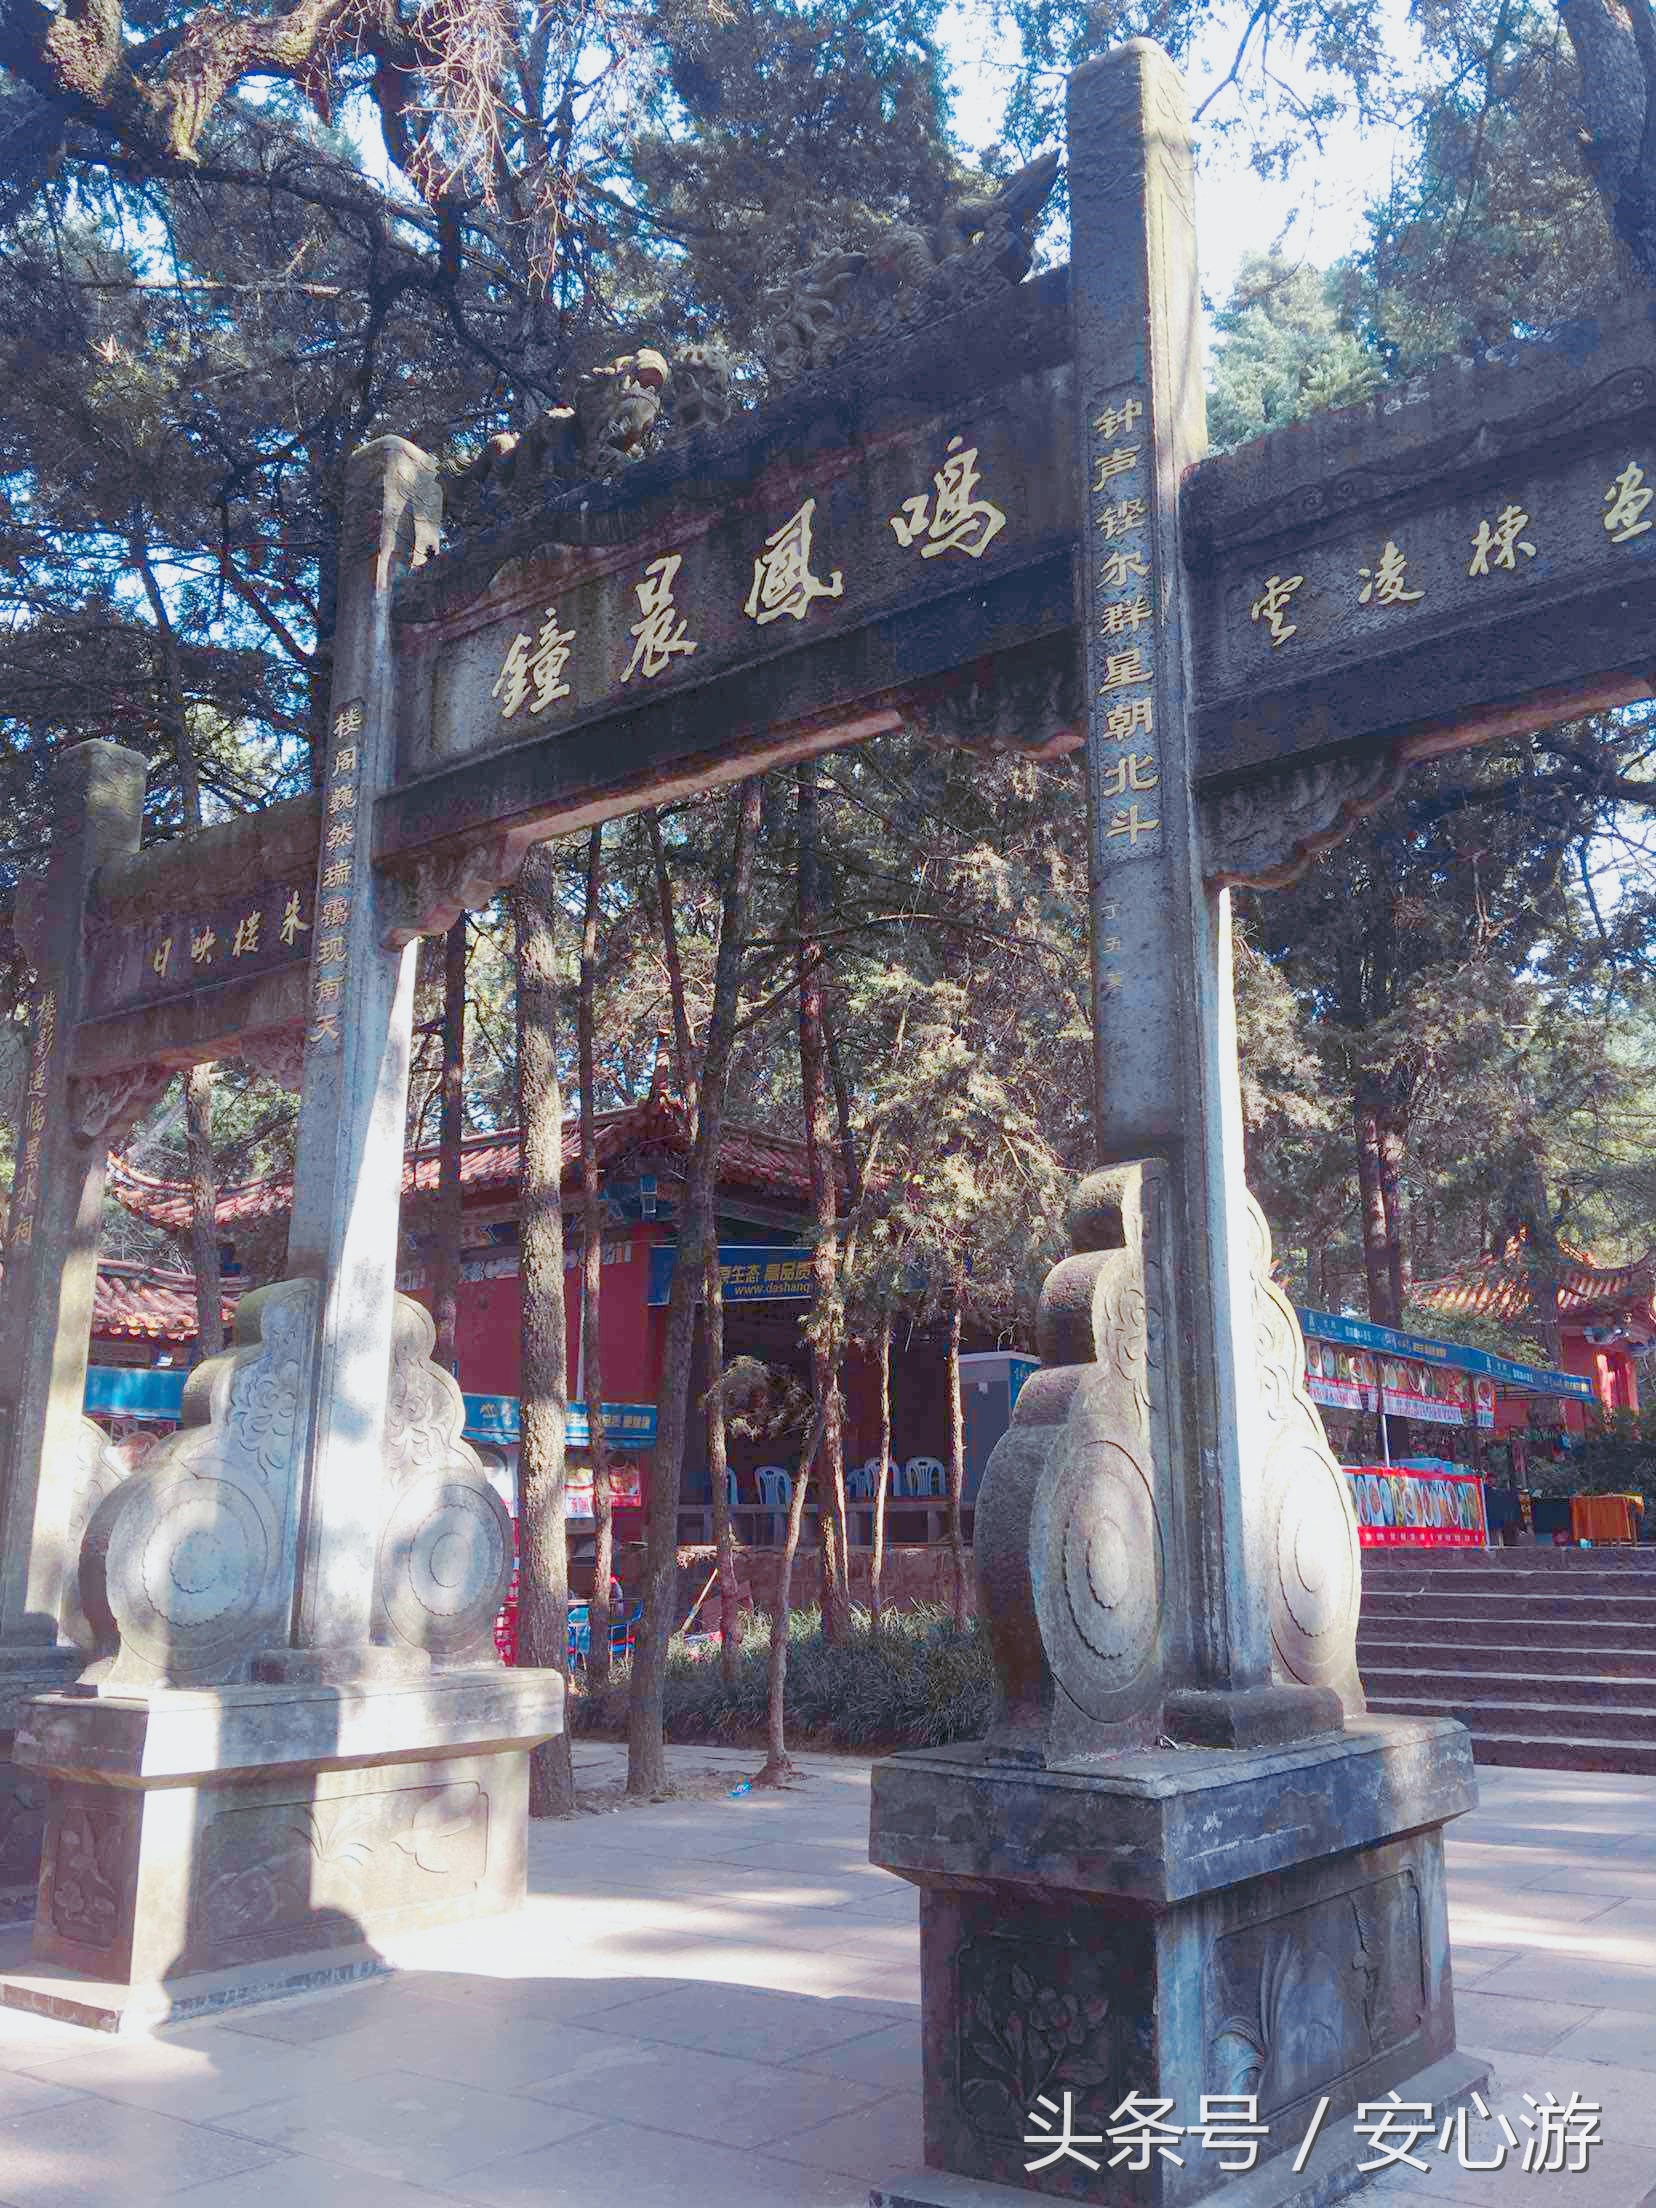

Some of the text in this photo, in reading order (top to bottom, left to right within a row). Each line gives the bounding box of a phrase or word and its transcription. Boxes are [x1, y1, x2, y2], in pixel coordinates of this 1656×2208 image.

[1092, 398, 1161, 845] 钟声铿尔群星朝北斗
